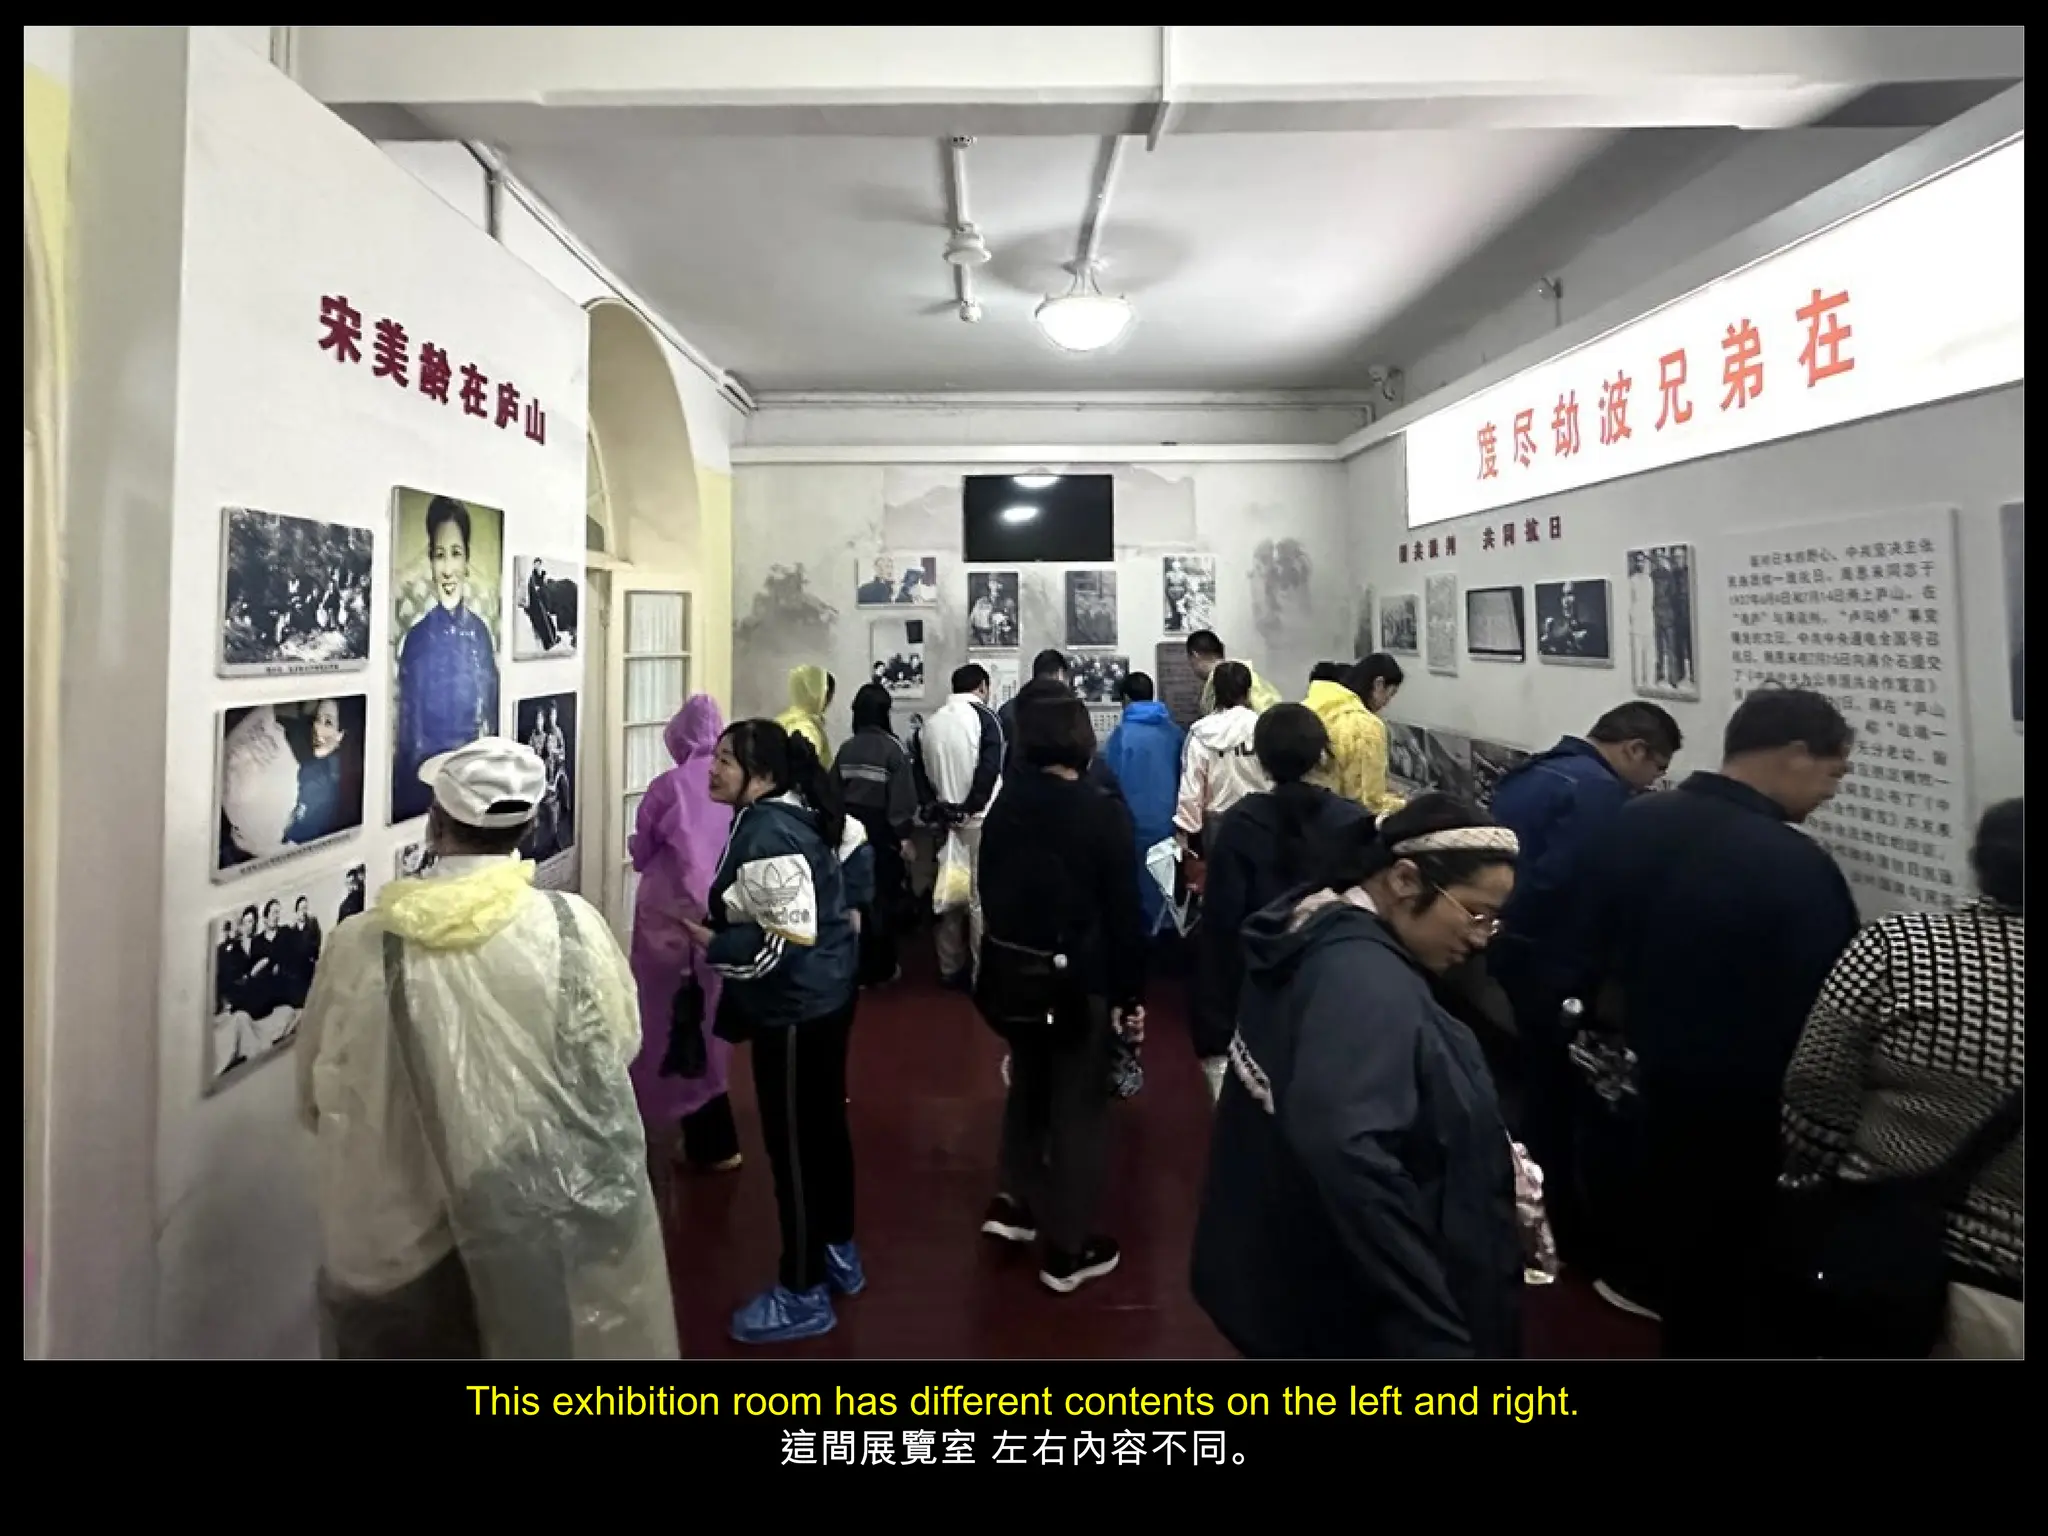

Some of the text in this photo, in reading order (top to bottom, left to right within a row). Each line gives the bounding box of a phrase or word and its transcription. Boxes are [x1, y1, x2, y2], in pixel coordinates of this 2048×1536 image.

[318, 294, 547, 446] 宋美龄在庐山
[1477, 289, 1856, 480] 度尽劫波兄弟在
[1482, 515, 1562, 550] 共同抗日
